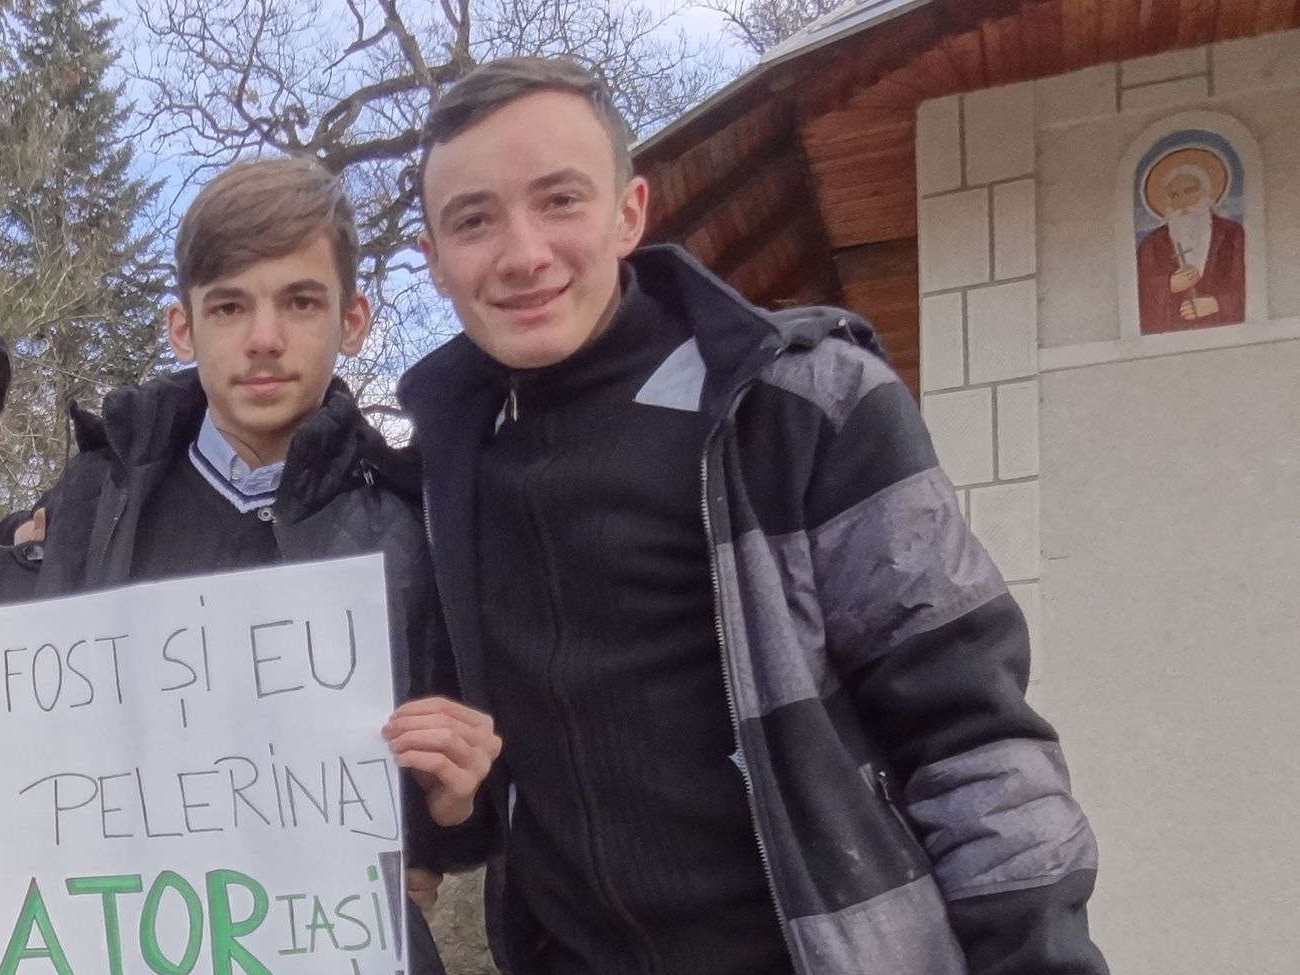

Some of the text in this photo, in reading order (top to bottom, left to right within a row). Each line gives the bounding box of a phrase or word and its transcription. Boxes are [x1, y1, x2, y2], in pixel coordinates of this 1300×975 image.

[3, 634, 130, 713] FOST
[249, 609, 357, 699] EU
[18, 742, 401, 846] PELERINAJ
